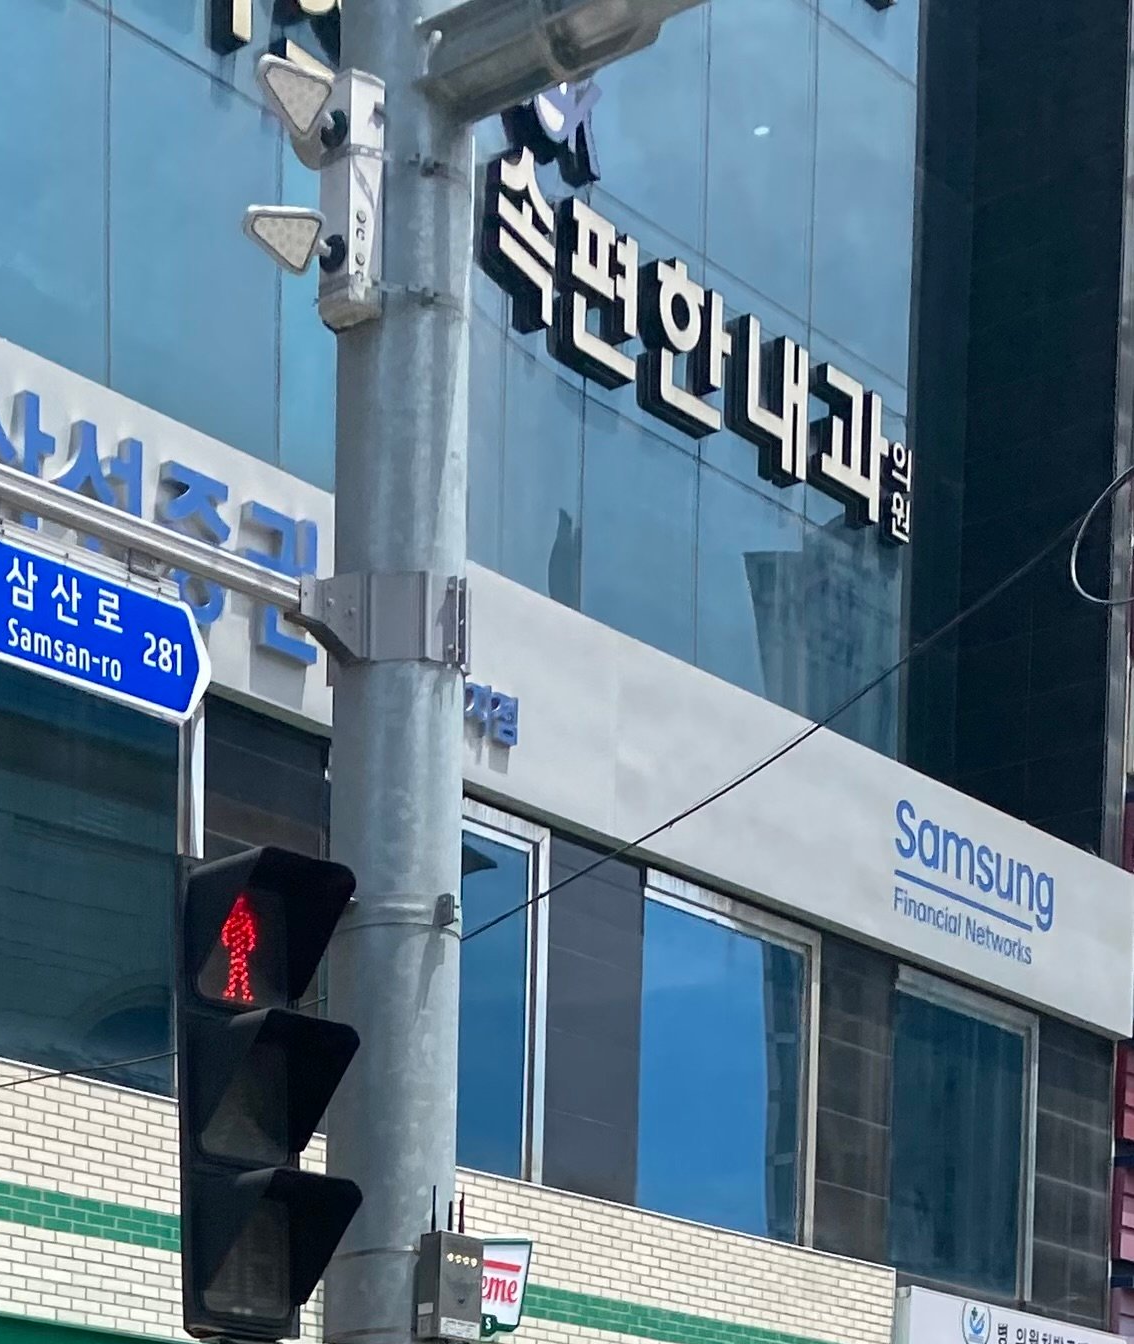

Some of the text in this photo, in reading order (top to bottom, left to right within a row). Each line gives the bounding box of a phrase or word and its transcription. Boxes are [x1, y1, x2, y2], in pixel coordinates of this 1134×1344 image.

[496, 146, 912, 544] 속편한내과 의원
[6, 556, 124, 634] 삼산로
[143, 631, 183, 677] 281
[7, 617, 122, 683] Samsan-ro
[893, 887, 1033, 965] Financial Networks
[894, 799, 1055, 932] Samsung
